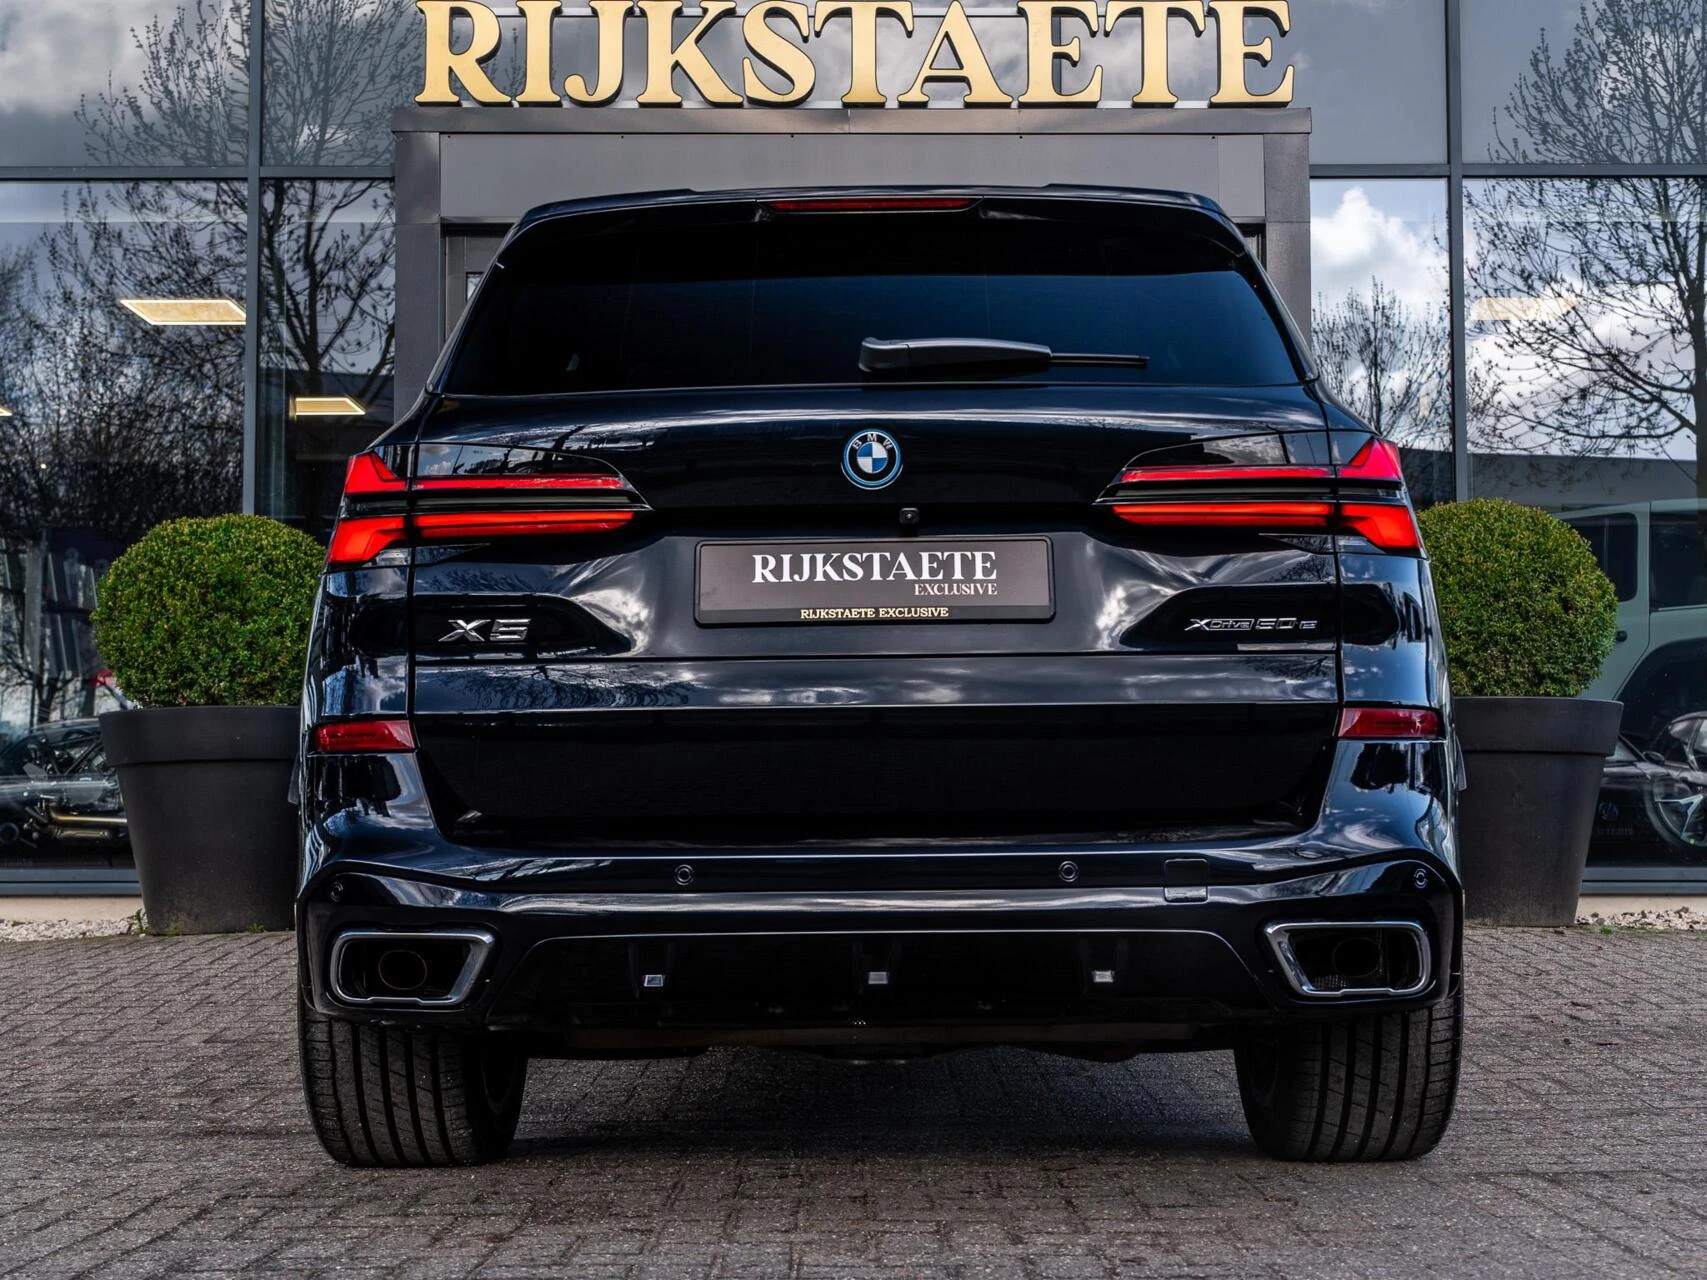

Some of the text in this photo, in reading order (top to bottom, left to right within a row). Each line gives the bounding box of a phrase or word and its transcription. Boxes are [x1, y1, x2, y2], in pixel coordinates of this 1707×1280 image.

[414, 0, 1294, 107] RIJKSTAETE
[852, 433, 893, 450] BMW
[752, 551, 997, 583] RIJKSTAETE
[914, 583, 998, 597] EXCLUSIVE
[801, 607, 949, 619] RIJKSTAETE EXCLUSIVE
[438, 618, 532, 642] X5
